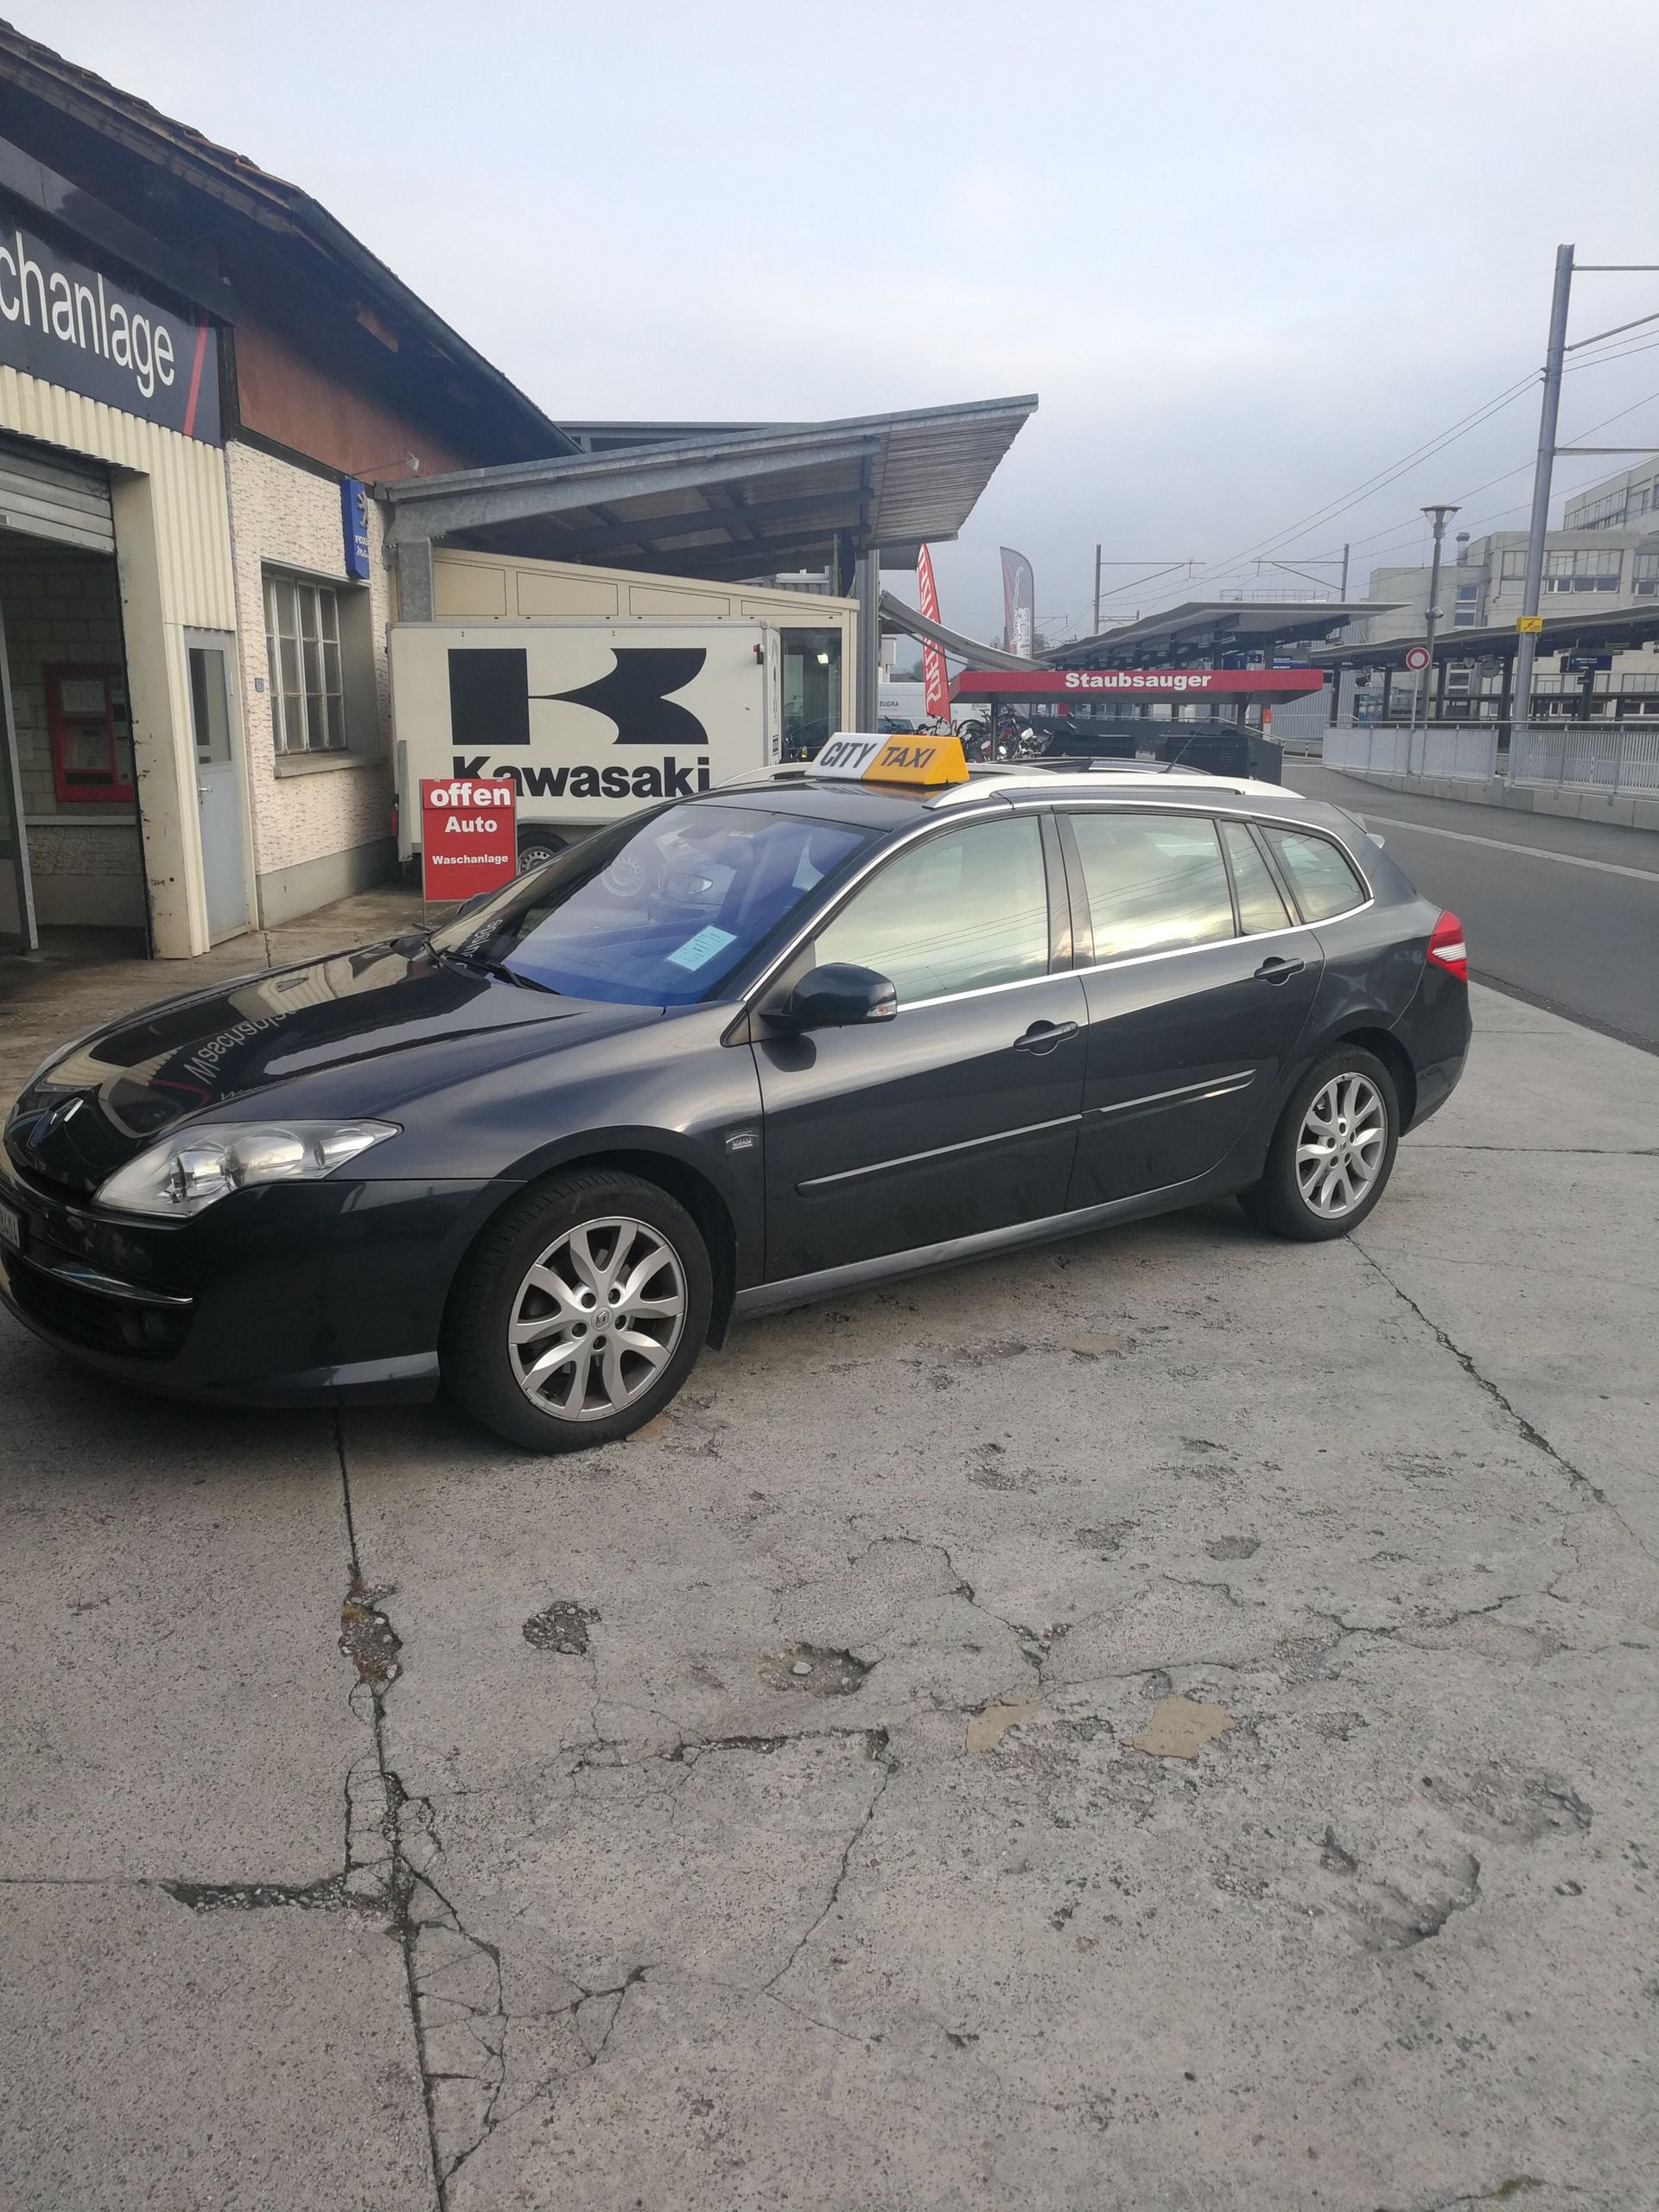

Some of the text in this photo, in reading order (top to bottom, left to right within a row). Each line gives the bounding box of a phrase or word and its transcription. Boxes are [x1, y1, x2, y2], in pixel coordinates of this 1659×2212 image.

[0, 230, 175, 398] chanlage
[1065, 672, 1211, 691] Staubsauger
[820, 741, 937, 768] CITY TAXI
[430, 782, 512, 807] offen
[444, 816, 498, 833] Auto
[432, 855, 509, 865] Waschanlage
